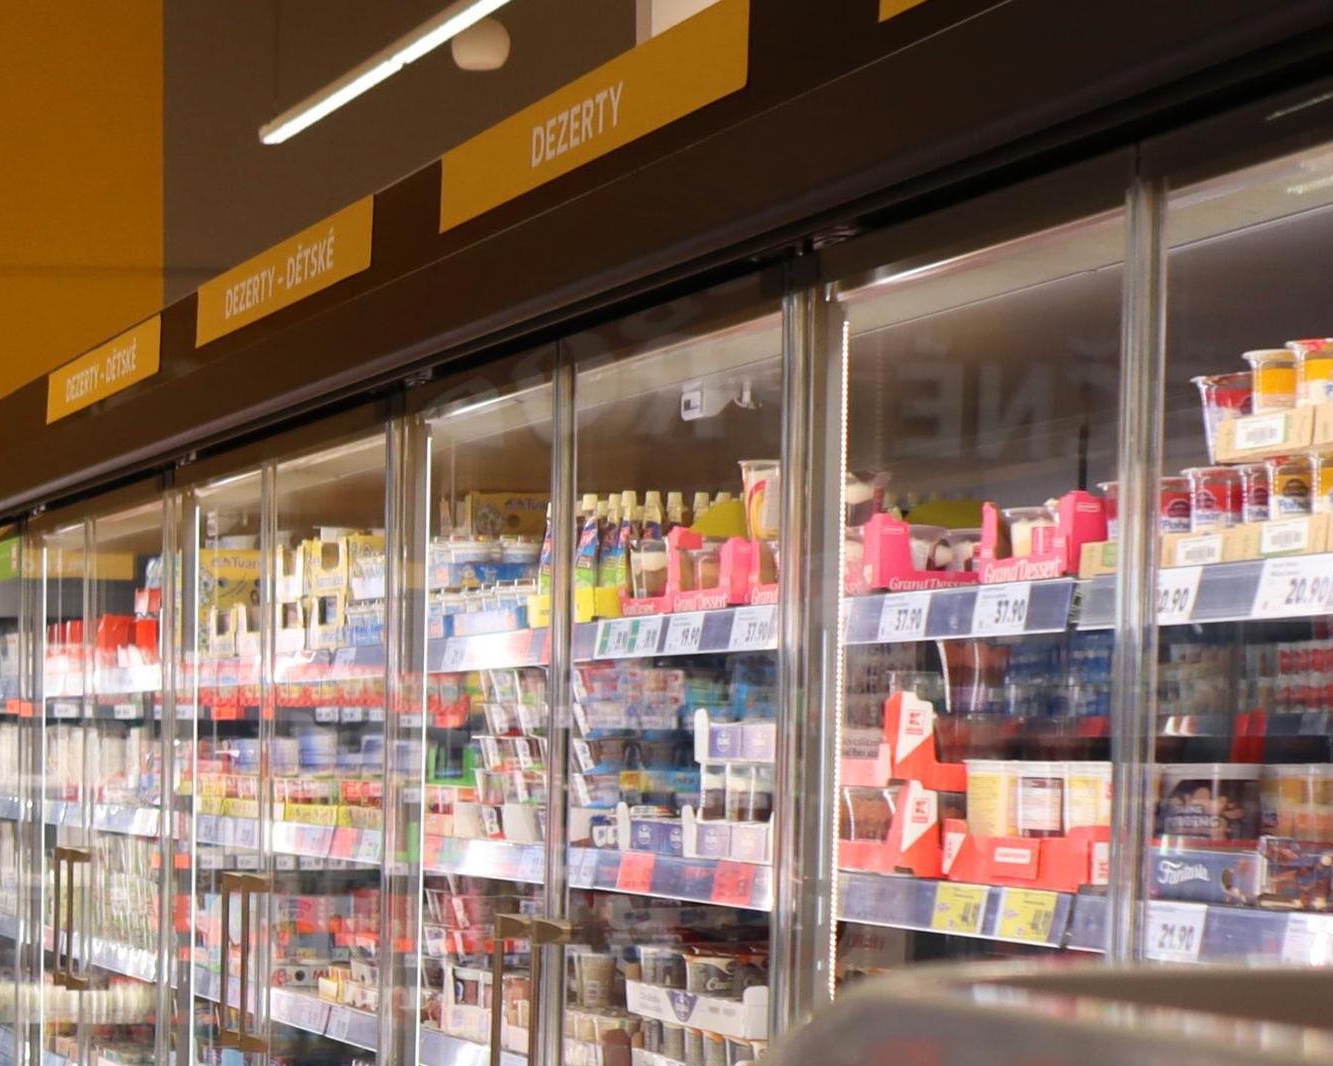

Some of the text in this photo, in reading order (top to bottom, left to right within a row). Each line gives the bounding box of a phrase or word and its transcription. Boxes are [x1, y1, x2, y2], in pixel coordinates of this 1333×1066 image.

[530, 82, 625, 169] DEZERTY
[224, 227, 336, 319] DEZERTY DĚTSKÉ
[65, 340, 137, 406] DEZERTY DĚTSKÉ
[894, 607, 922, 632] 37.90
[994, 599, 1025, 625] 37.90
[1158, 860, 1211, 885] Fantasia
